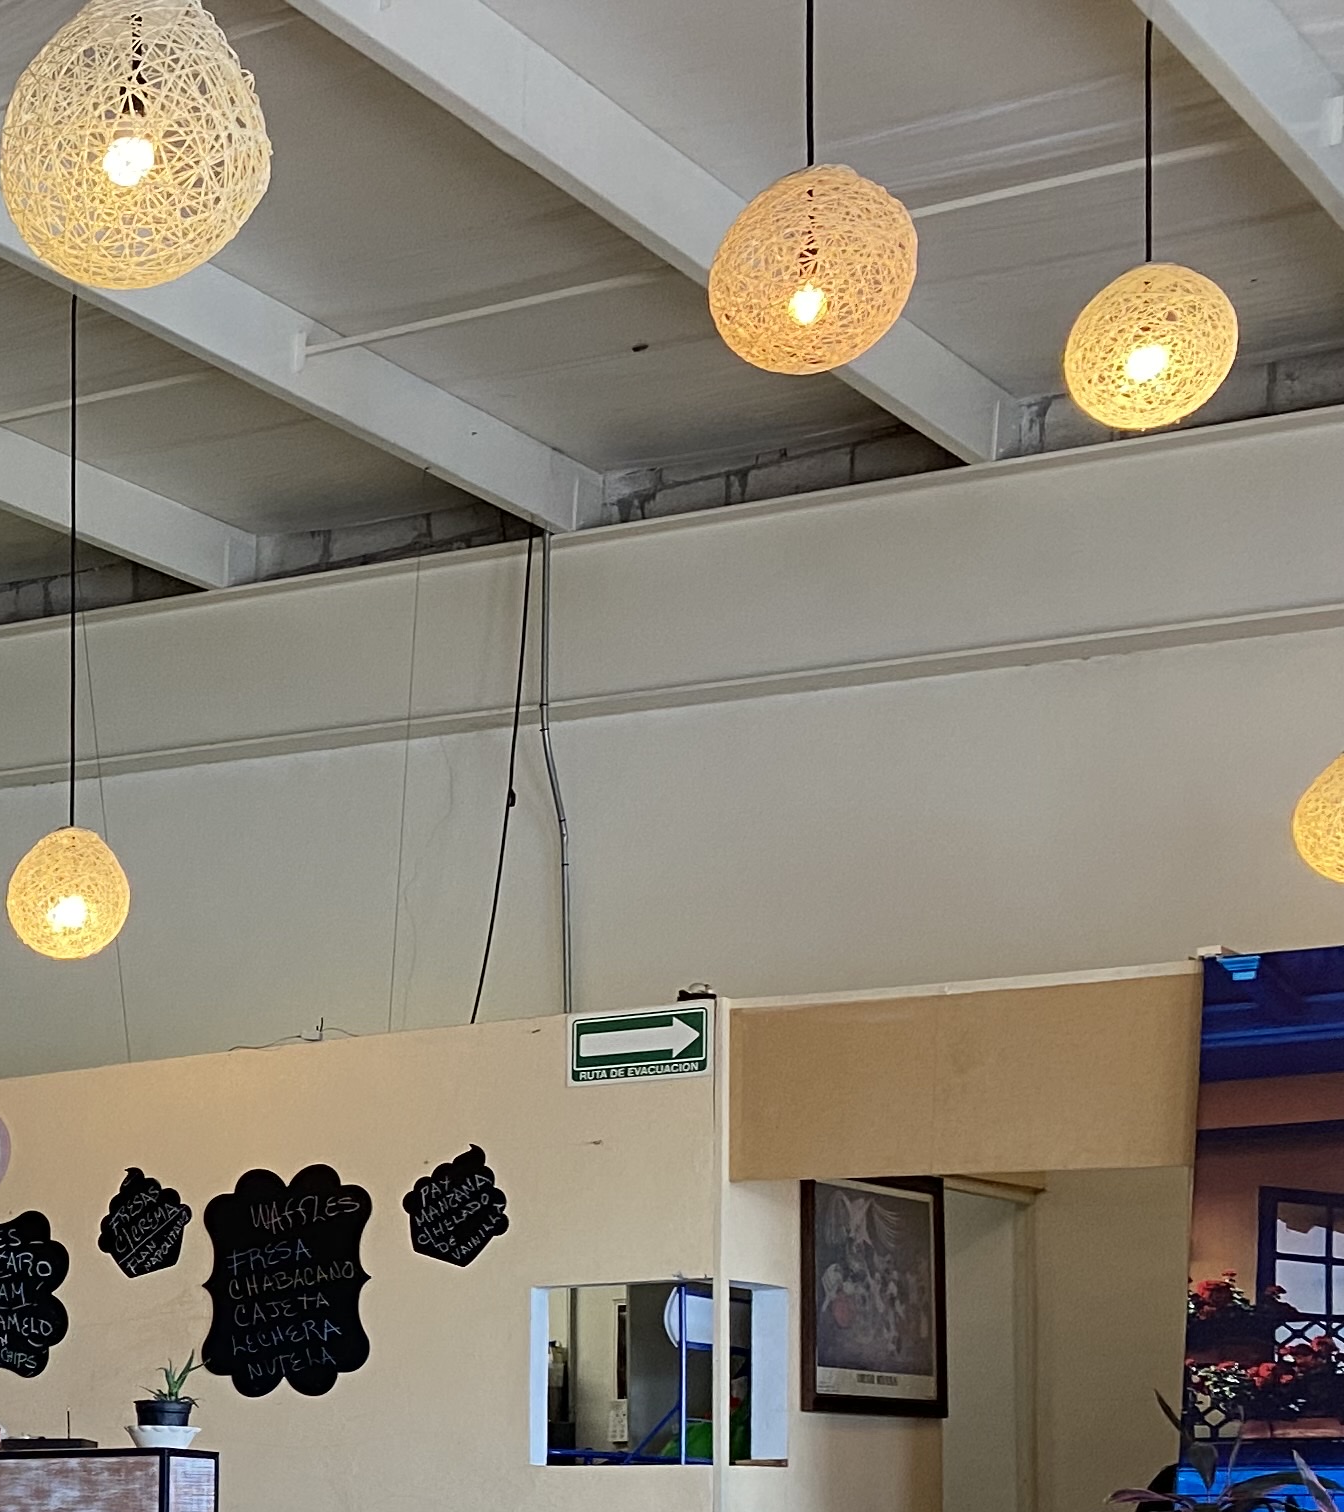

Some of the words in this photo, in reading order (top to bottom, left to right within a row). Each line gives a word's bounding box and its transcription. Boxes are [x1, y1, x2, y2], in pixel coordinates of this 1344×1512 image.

[579, 1070, 608, 1081] RUTA
[611, 1068, 625, 1077] DE
[627, 1061, 699, 1077] EVACUACION
[109, 1185, 160, 1236] FRESAS
[415, 1174, 492, 1227] MANZANA
[226, 1238, 312, 1276] FRESA
[228, 1261, 355, 1300] CHABACANO
[234, 1292, 330, 1327] CAJETA
[231, 1319, 342, 1356] LECHERA
